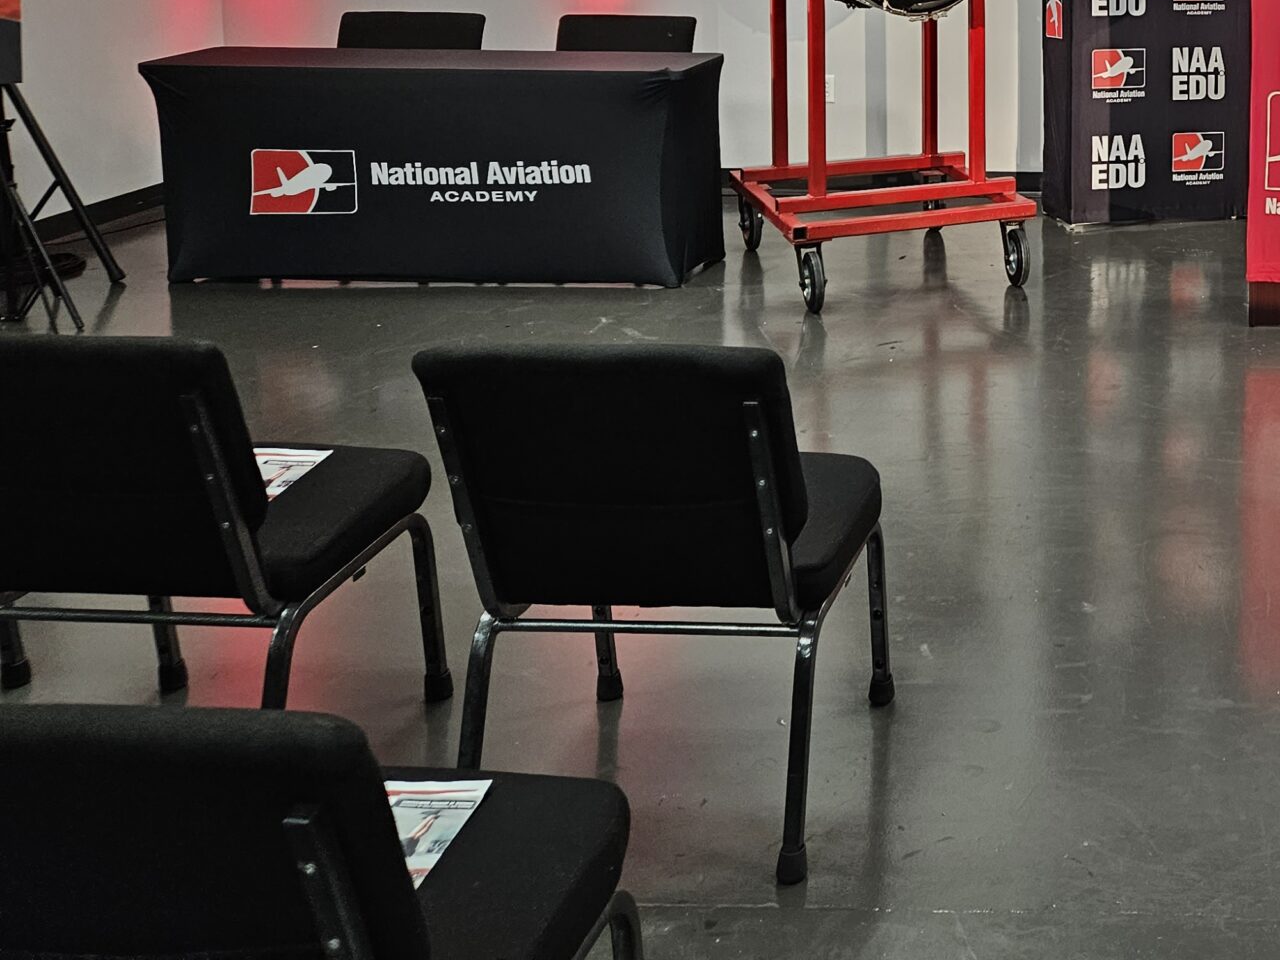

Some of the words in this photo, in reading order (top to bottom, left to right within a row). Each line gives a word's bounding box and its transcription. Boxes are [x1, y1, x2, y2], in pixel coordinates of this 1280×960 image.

[1173, 2, 1198, 10] National
[1200, 2, 1226, 11] Aviation
[1172, 46, 1224, 73] NAA
[1092, 90, 1118, 98] National
[1120, 90, 1146, 98] Aviation
[1172, 74, 1226, 100] EDU
[1092, 134, 1146, 162] NAA
[370, 162, 479, 186] National
[486, 160, 592, 184] Aviation
[1092, 162, 1146, 190] EDU
[1172, 172, 1198, 182] National
[1198, 172, 1224, 180] Aviation
[430, 190, 538, 202] ACADEMY
